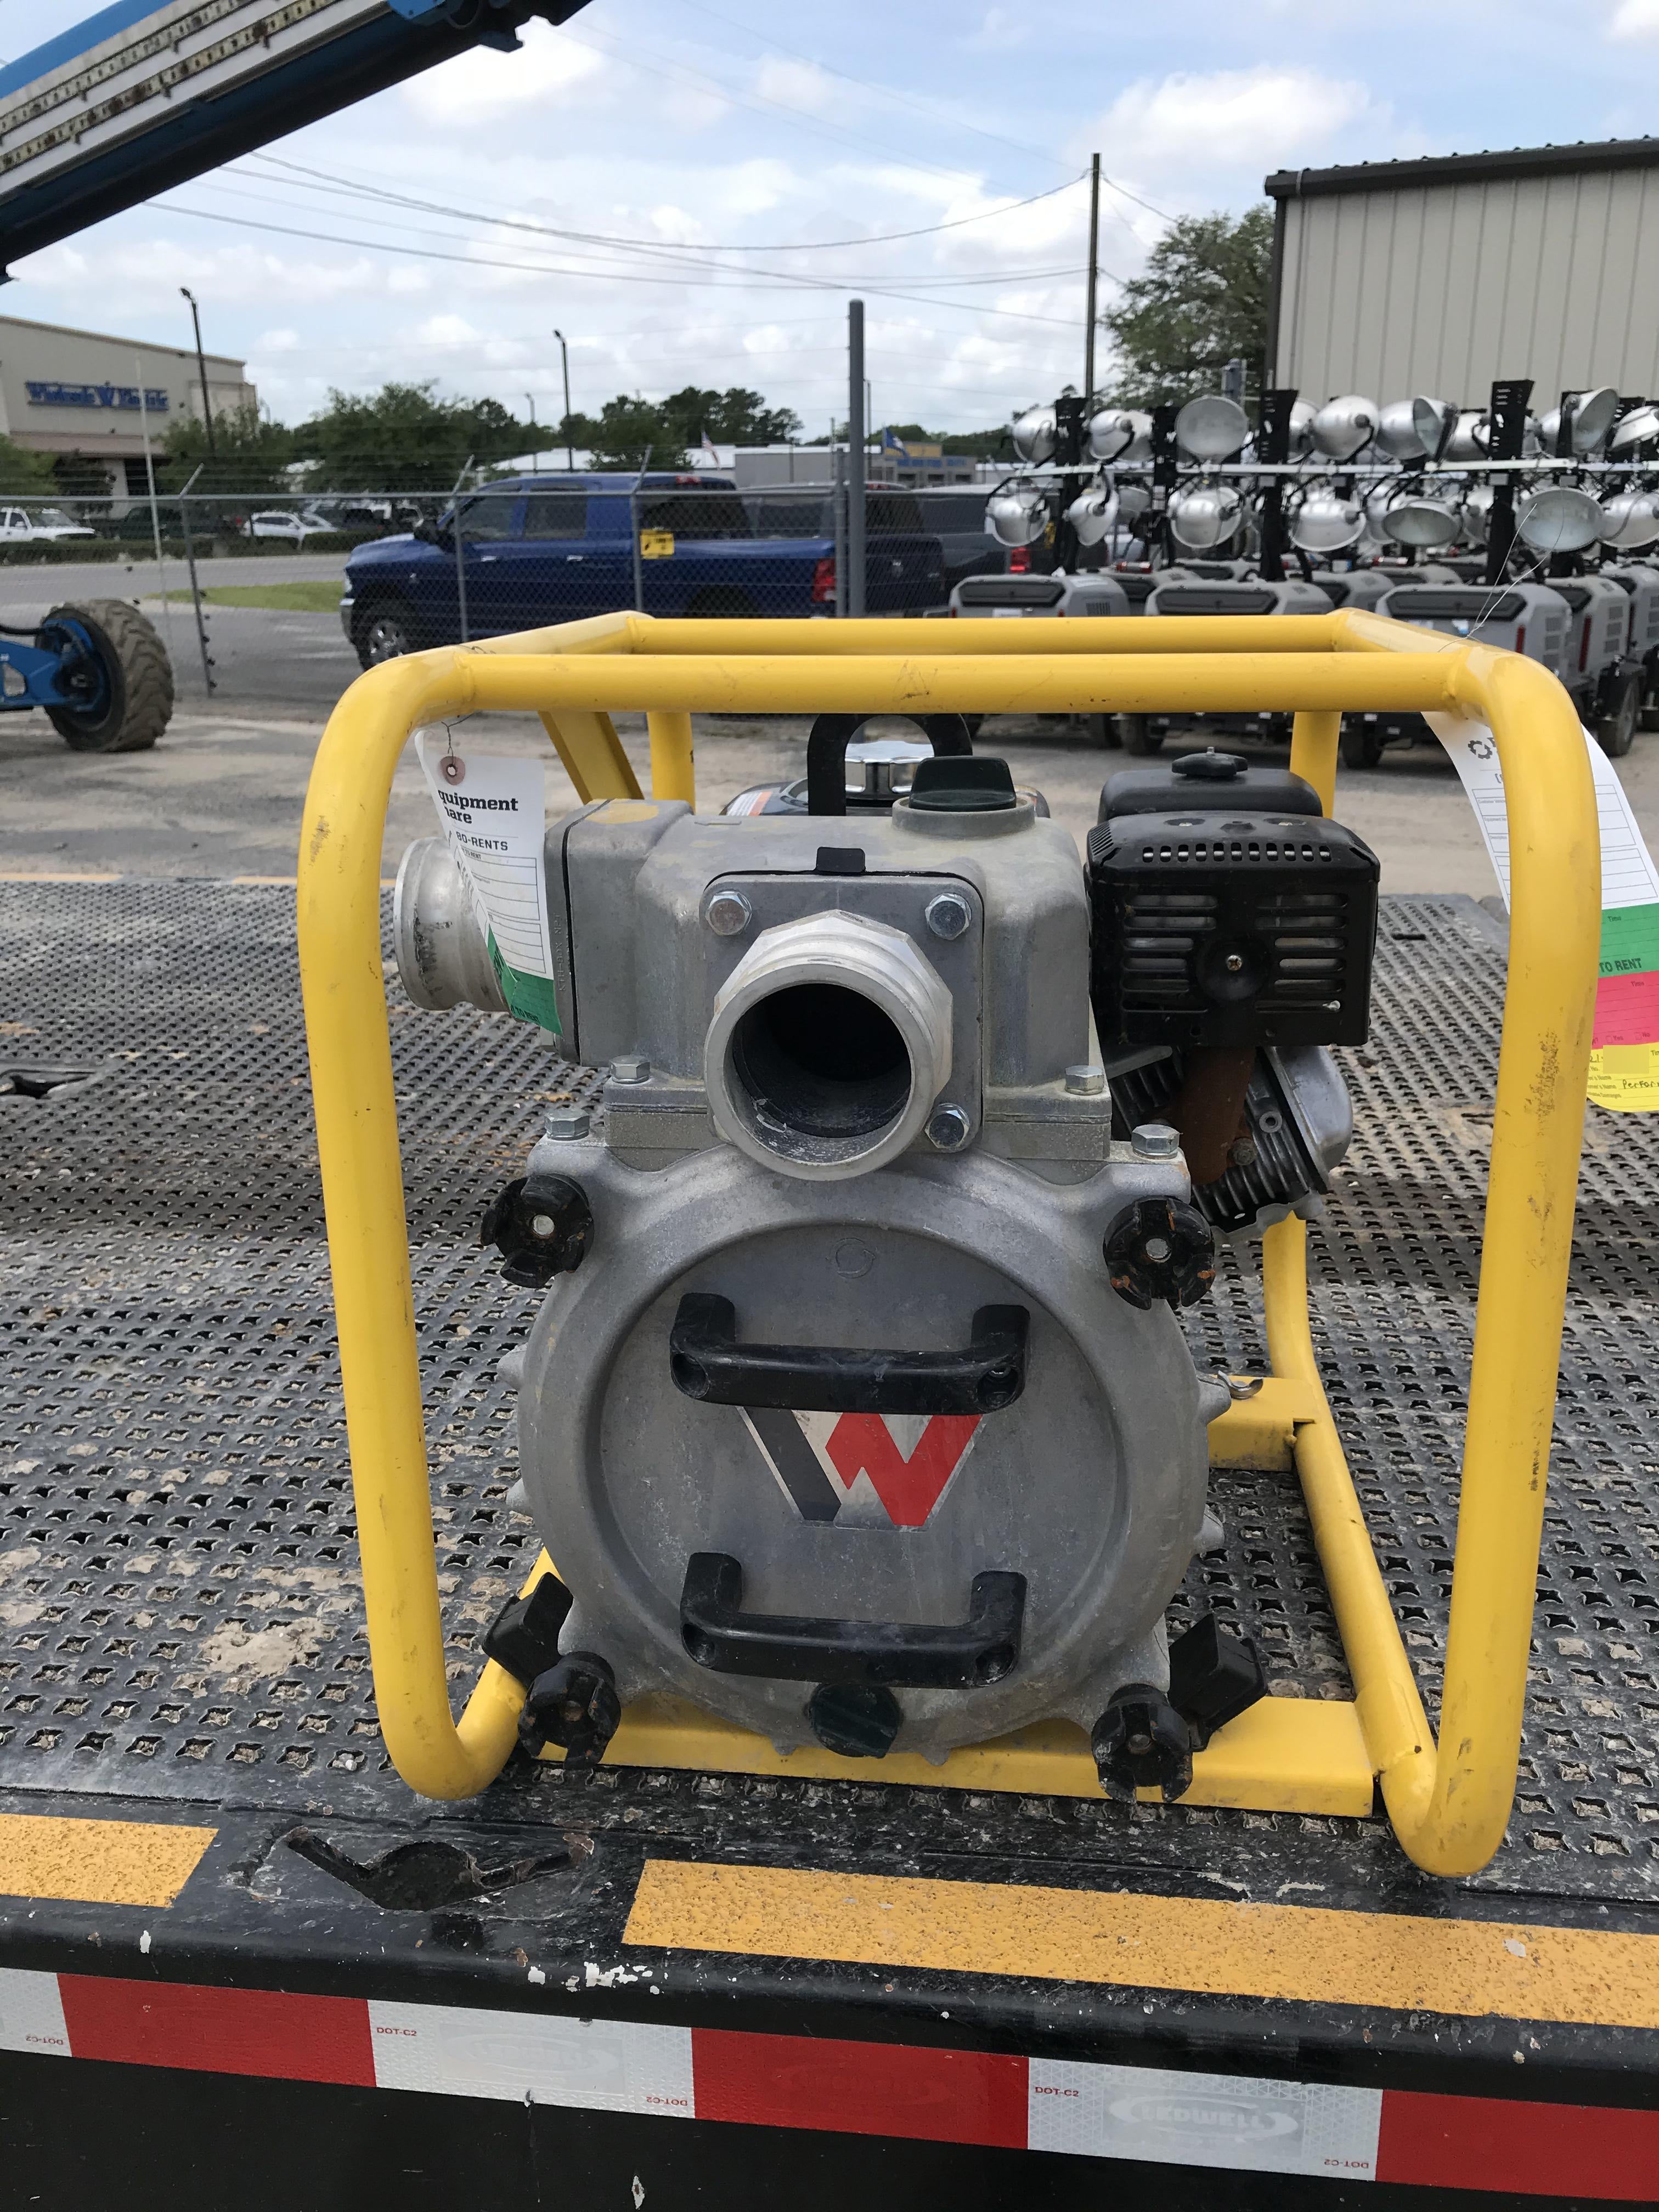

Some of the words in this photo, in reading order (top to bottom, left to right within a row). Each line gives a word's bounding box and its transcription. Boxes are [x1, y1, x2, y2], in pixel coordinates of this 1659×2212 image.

[438, 790, 518, 811] quipment
[1599, 961, 1613, 973] TO
[1614, 957, 1642, 971] RENT
[376, 2027, 417, 2037] DOT-C2
[26, 2036, 64, 2045] DOT-C2
[1035, 2086, 1079, 2097] DOT-C2
[646, 2096, 689, 2107] DOT-C2
[1324, 2159, 1370, 2169] DOT-C2
